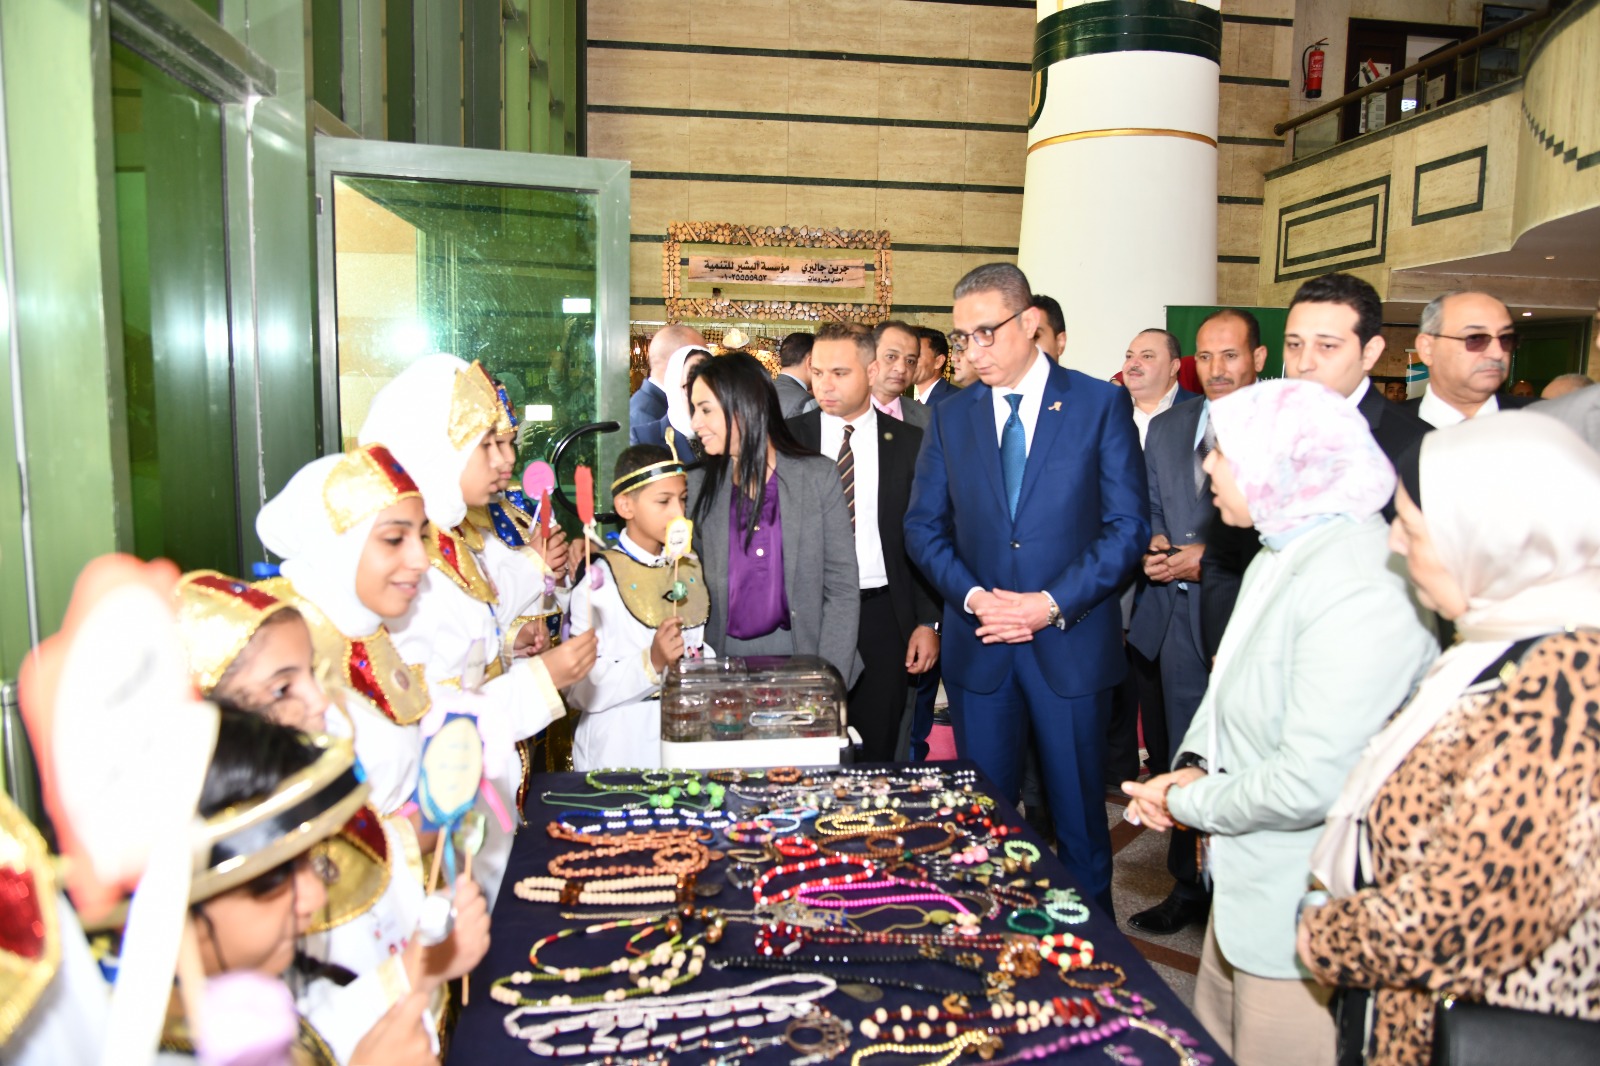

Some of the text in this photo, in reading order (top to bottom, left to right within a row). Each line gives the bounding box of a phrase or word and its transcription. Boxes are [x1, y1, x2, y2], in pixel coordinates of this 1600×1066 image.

[704, 260, 790, 273] مؤسسة البشير للتنمية
[801, 263, 849, 275] جرين جاليري
